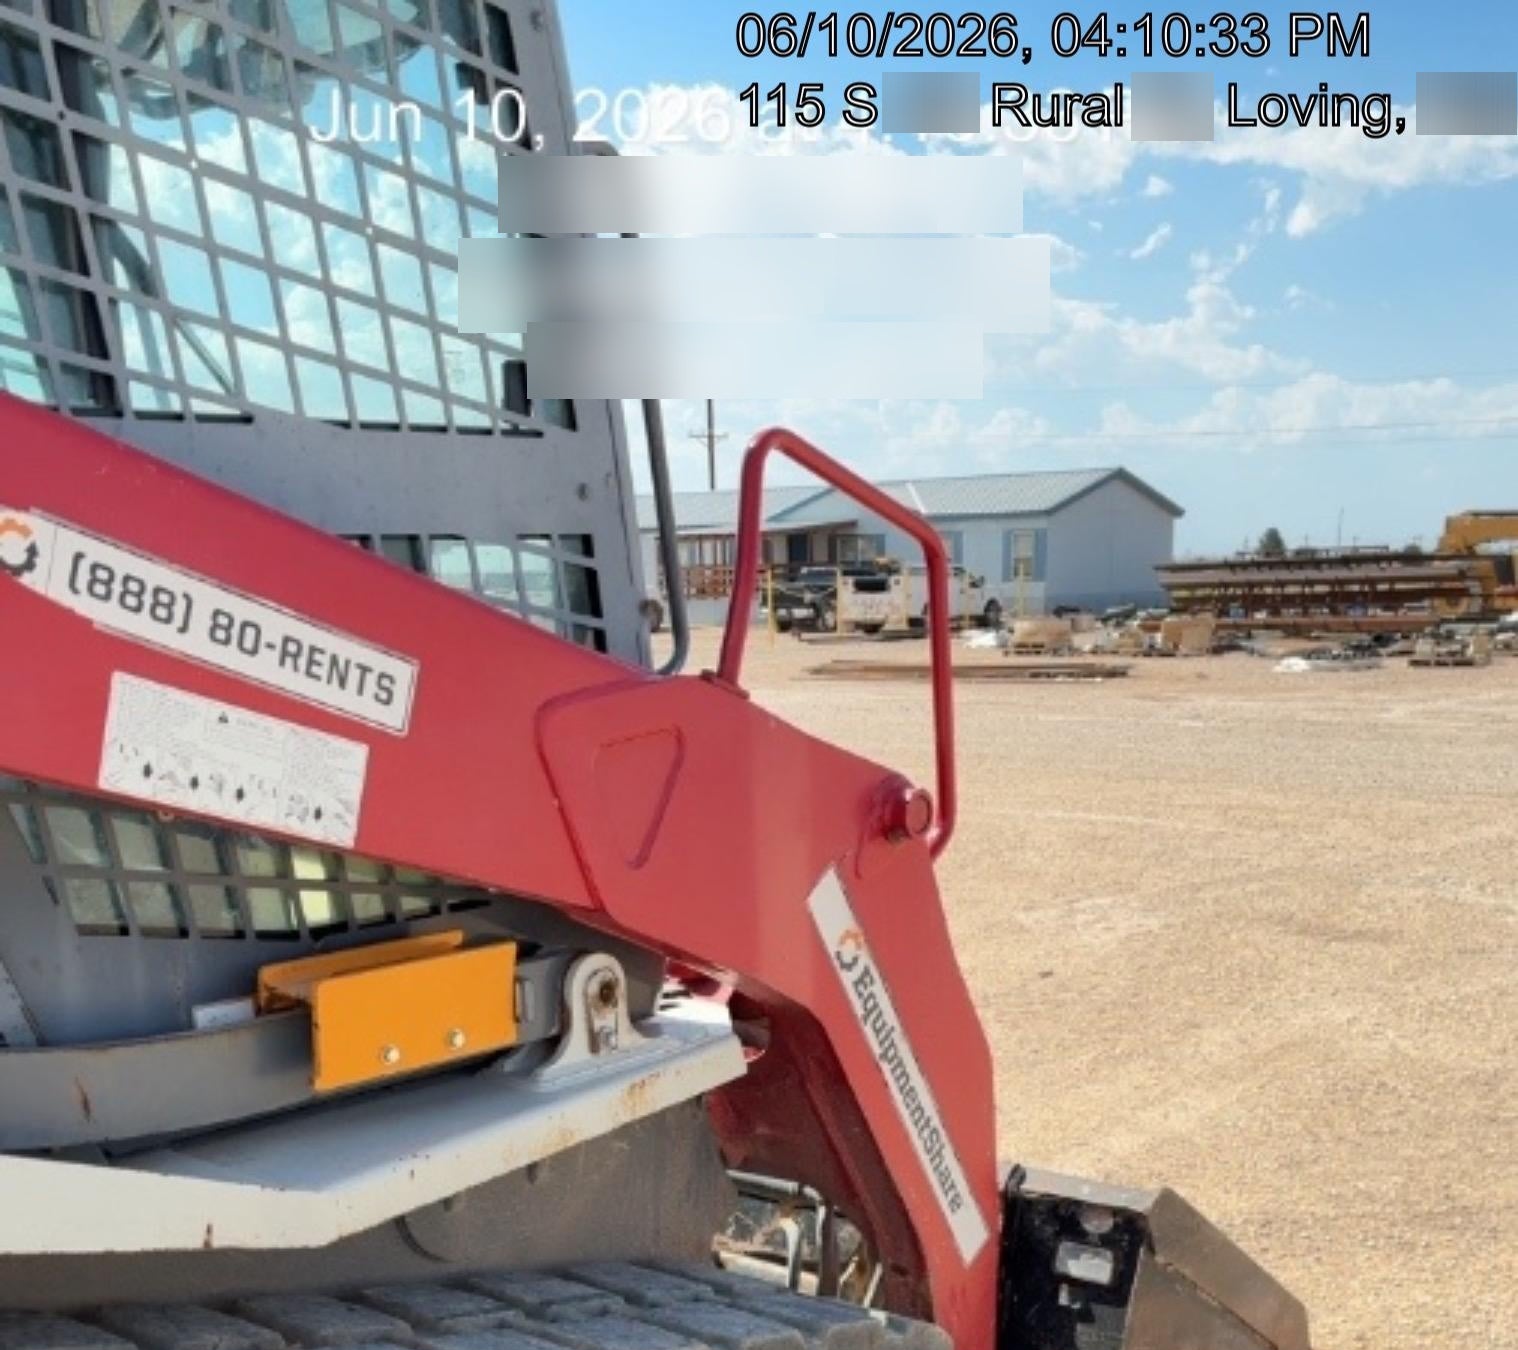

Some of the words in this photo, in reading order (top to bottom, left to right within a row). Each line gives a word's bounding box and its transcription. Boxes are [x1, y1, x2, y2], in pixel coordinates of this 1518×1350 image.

[68, 551, 193, 634] (888)
[208, 608, 397, 707] 80-RENTS
[852, 969, 964, 1214] EquipmentShare
